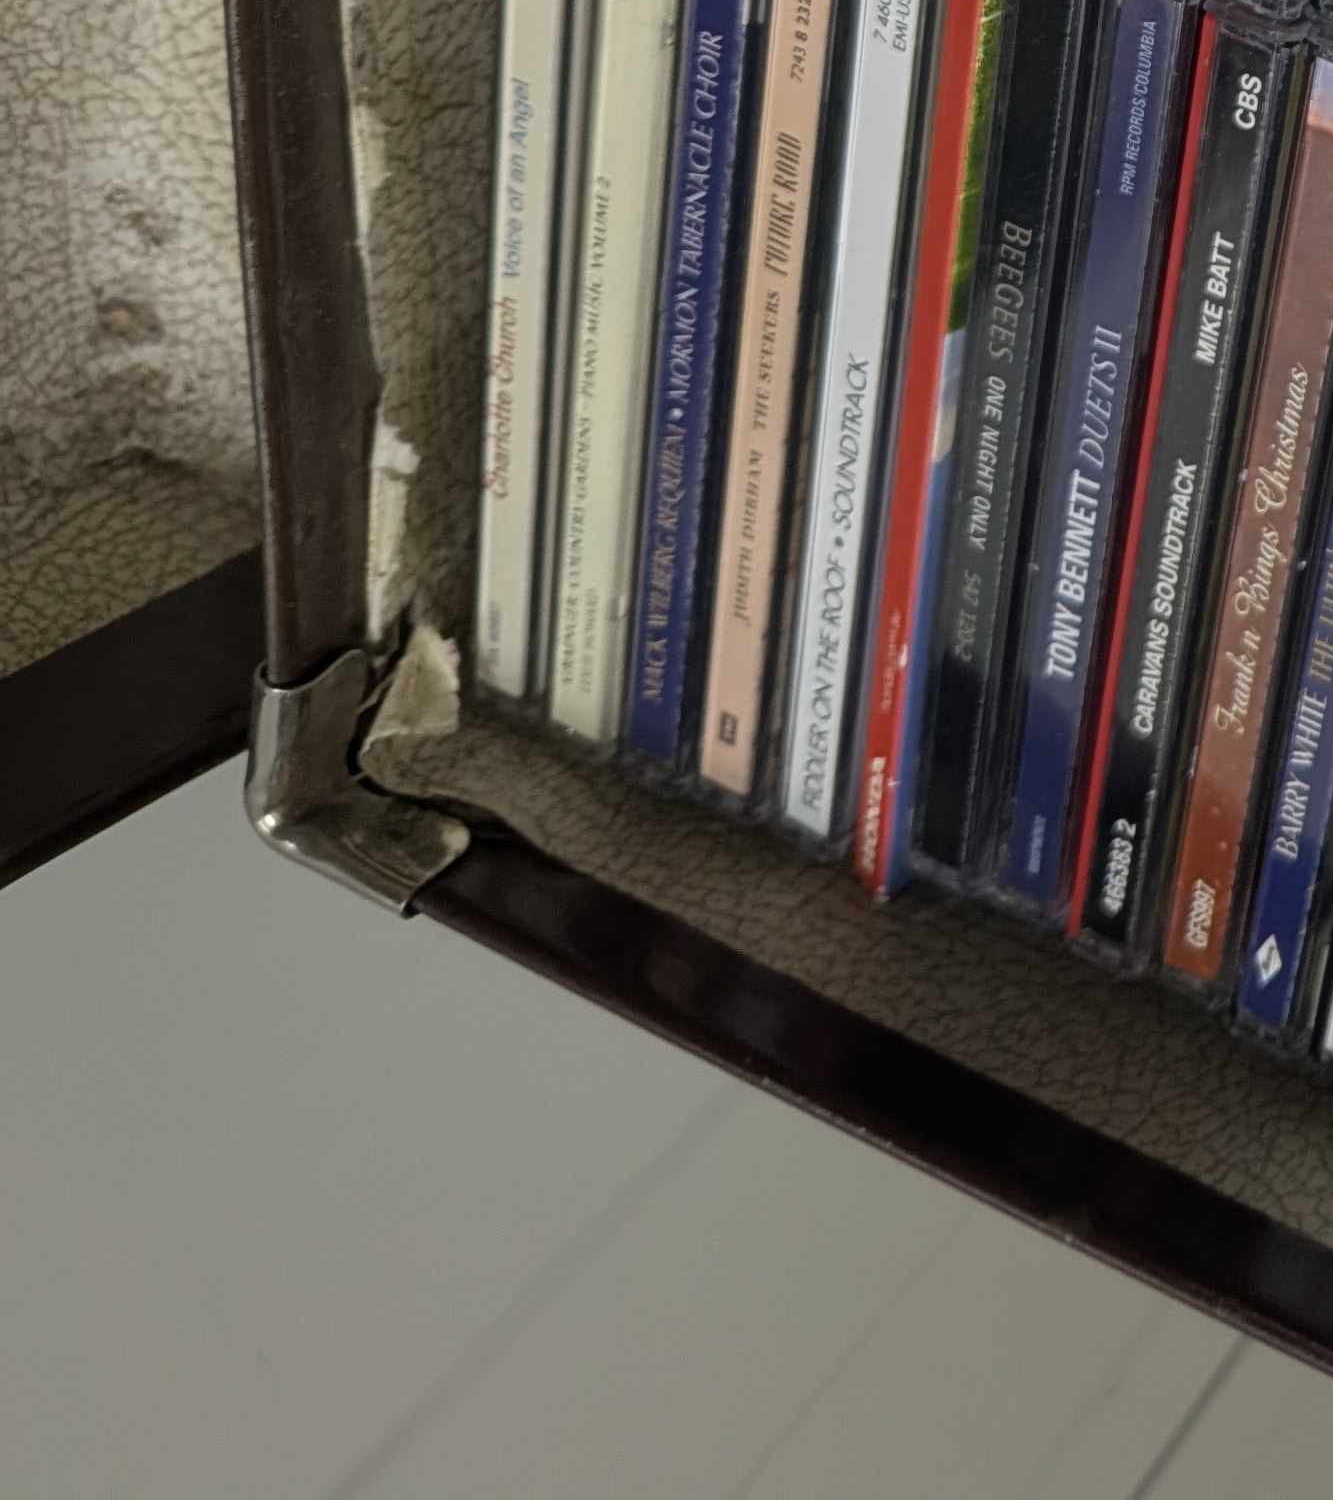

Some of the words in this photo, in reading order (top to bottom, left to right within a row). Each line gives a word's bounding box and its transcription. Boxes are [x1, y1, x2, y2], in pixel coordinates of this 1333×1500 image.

[1232, 72, 1263, 130] CBS
[678, 129, 711, 274] TABERNACLE
[695, 31, 721, 118] CHOIR
[773, 129, 800, 192] ROAD
[482, 389, 516, 500] Charlotte
[506, 77, 533, 147] Angel
[1204, 231, 1237, 298] BATT
[1193, 300, 1224, 363] MIKE
[832, 361, 867, 523] SOUNDTRACK
[974, 423, 1001, 493] NIGHT
[966, 494, 993, 551] ONLY
[1057, 469, 1103, 602] BENNETT
[1214, 651, 1255, 732] Frank
[1254, 368, 1307, 512] Christmas
[1130, 618, 1170, 734] CARAVANS
[1151, 458, 1198, 616] SOUNDTRACK
[1045, 602, 1085, 680] TONY
[1286, 686, 1325, 764] WHITE
[1271, 778, 1309, 861] BARRY
